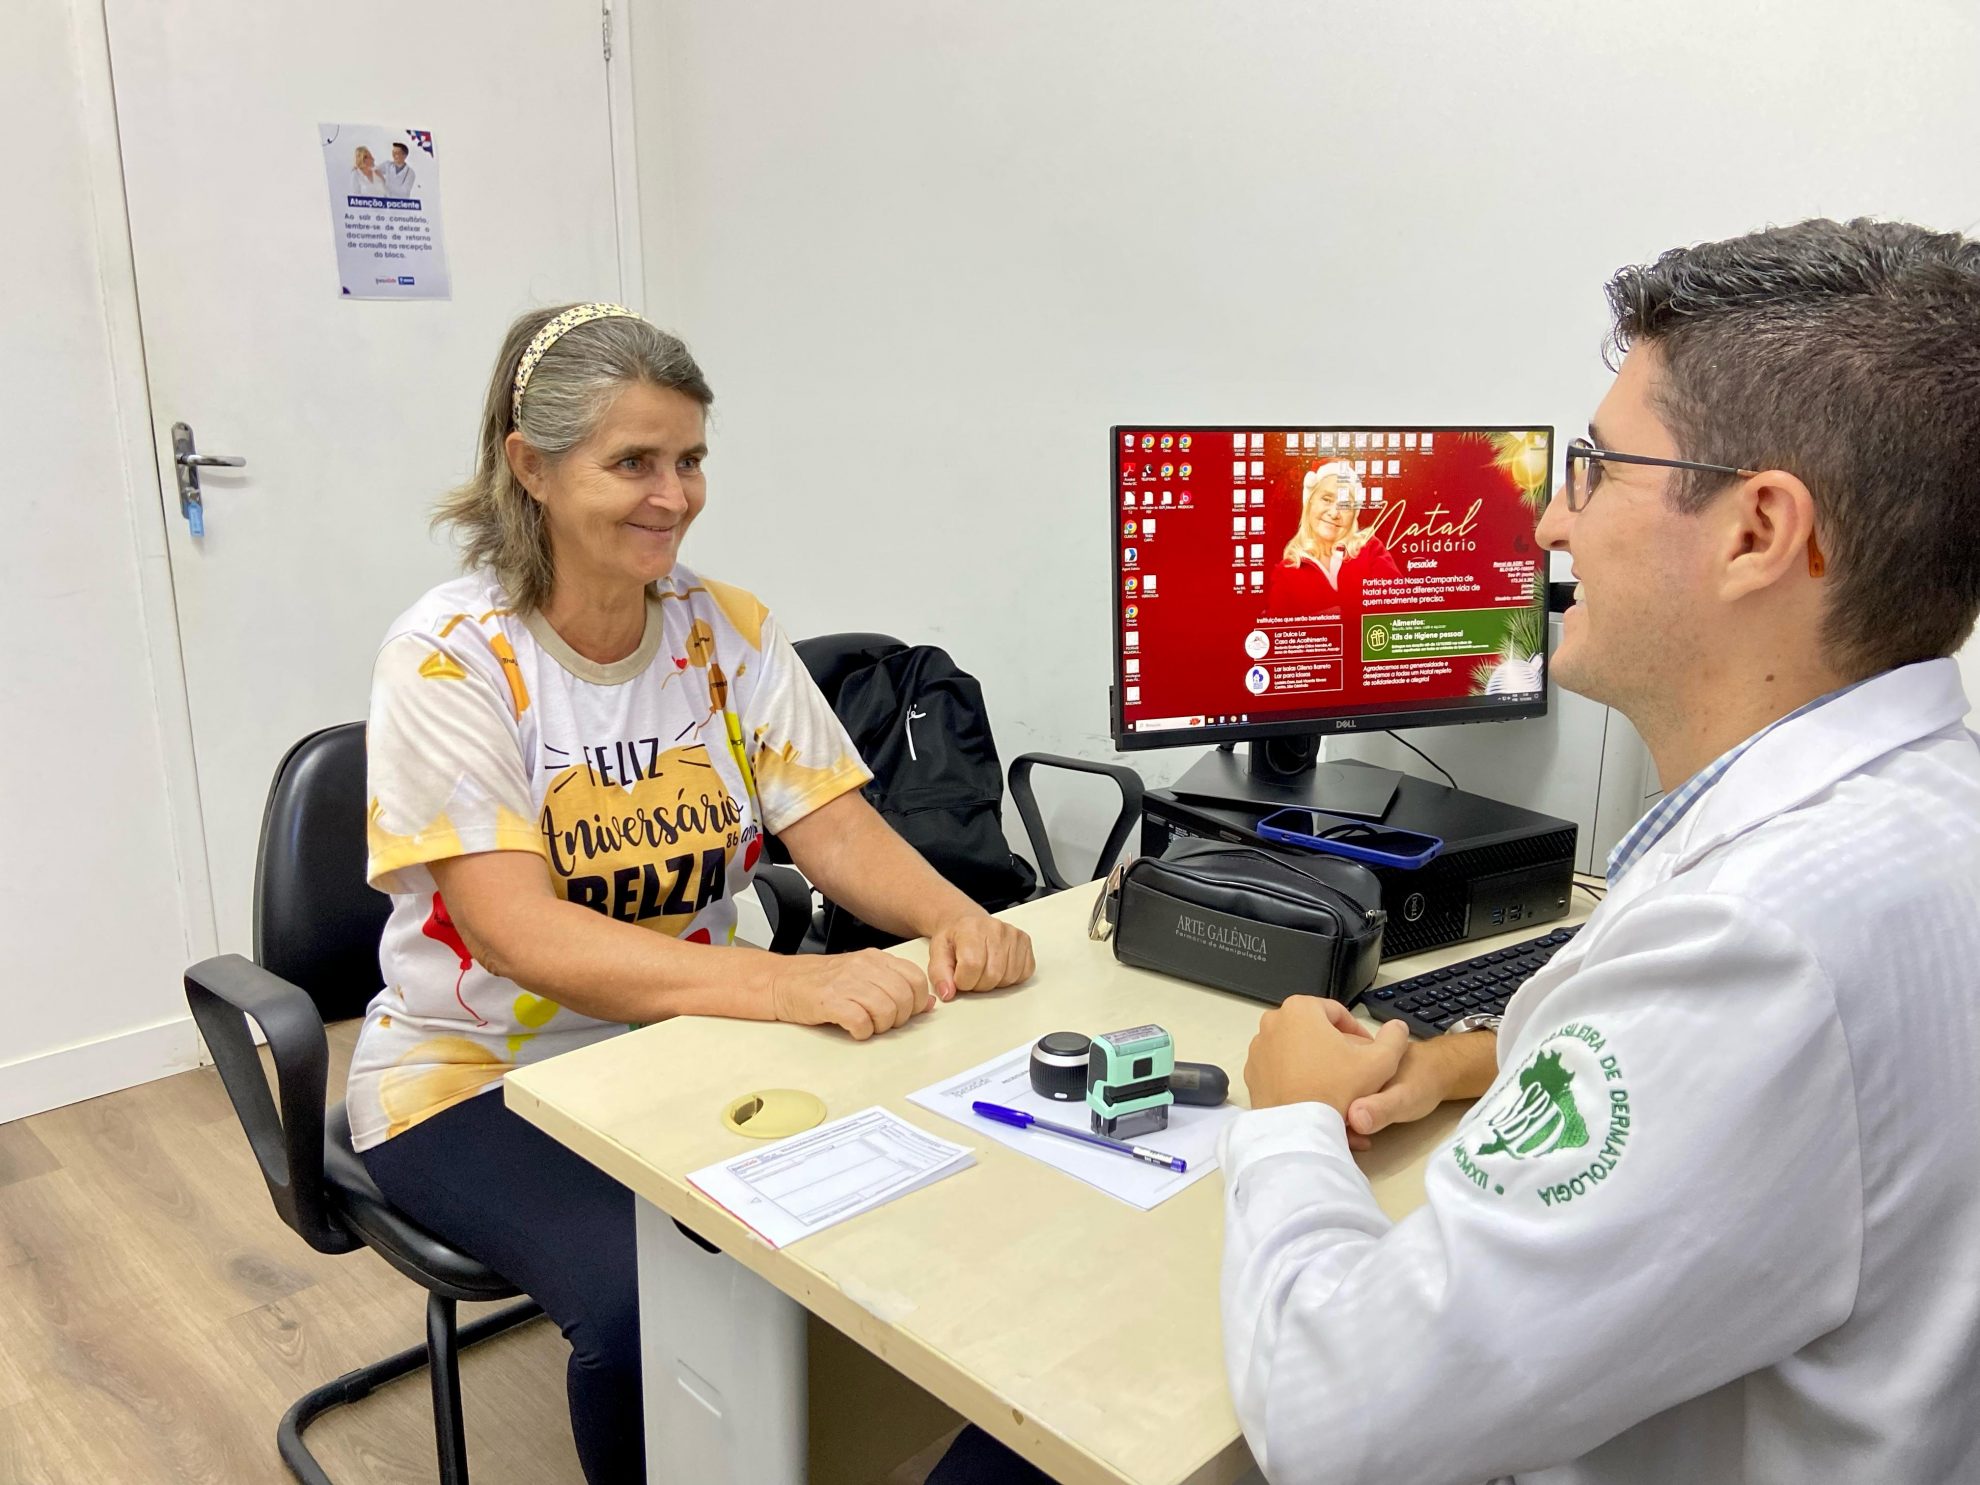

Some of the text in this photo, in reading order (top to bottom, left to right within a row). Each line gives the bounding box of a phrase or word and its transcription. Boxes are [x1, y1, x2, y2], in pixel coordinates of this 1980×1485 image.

[386, 201, 420, 210] paciente
[346, 232, 388, 240] documento
[1364, 498, 1482, 551] Natal
[1401, 538, 1476, 554] solidário
[1362, 578, 1392, 587] Participe
[1394, 577, 1403, 585] da
[1404, 577, 1424, 585] Nossa
[1426, 575, 1463, 585] Campanha
[1362, 588, 1381, 596] Natal
[1388, 586, 1404, 596] faça
[1412, 585, 1444, 594] diferença
[1456, 584, 1470, 592] vida
[1362, 598, 1383, 607] quem
[1384, 596, 1418, 604] realmente
[1392, 633, 1403, 641] Kits
[1414, 631, 1438, 641] Higiene
[1440, 630, 1464, 639] pessoal
[1336, 720, 1356, 728] DELL
[583, 737, 664, 787] FELIZ
[541, 788, 744, 877] Aniversário
[726, 833, 739, 848] 86
[566, 847, 726, 923] BELZA
[1177, 914, 1267, 955] ARTE GALÊNICA
[1600, 1055, 1622, 1082] DE
[1537, 1089, 1631, 1207] DERMATOLOGIA
